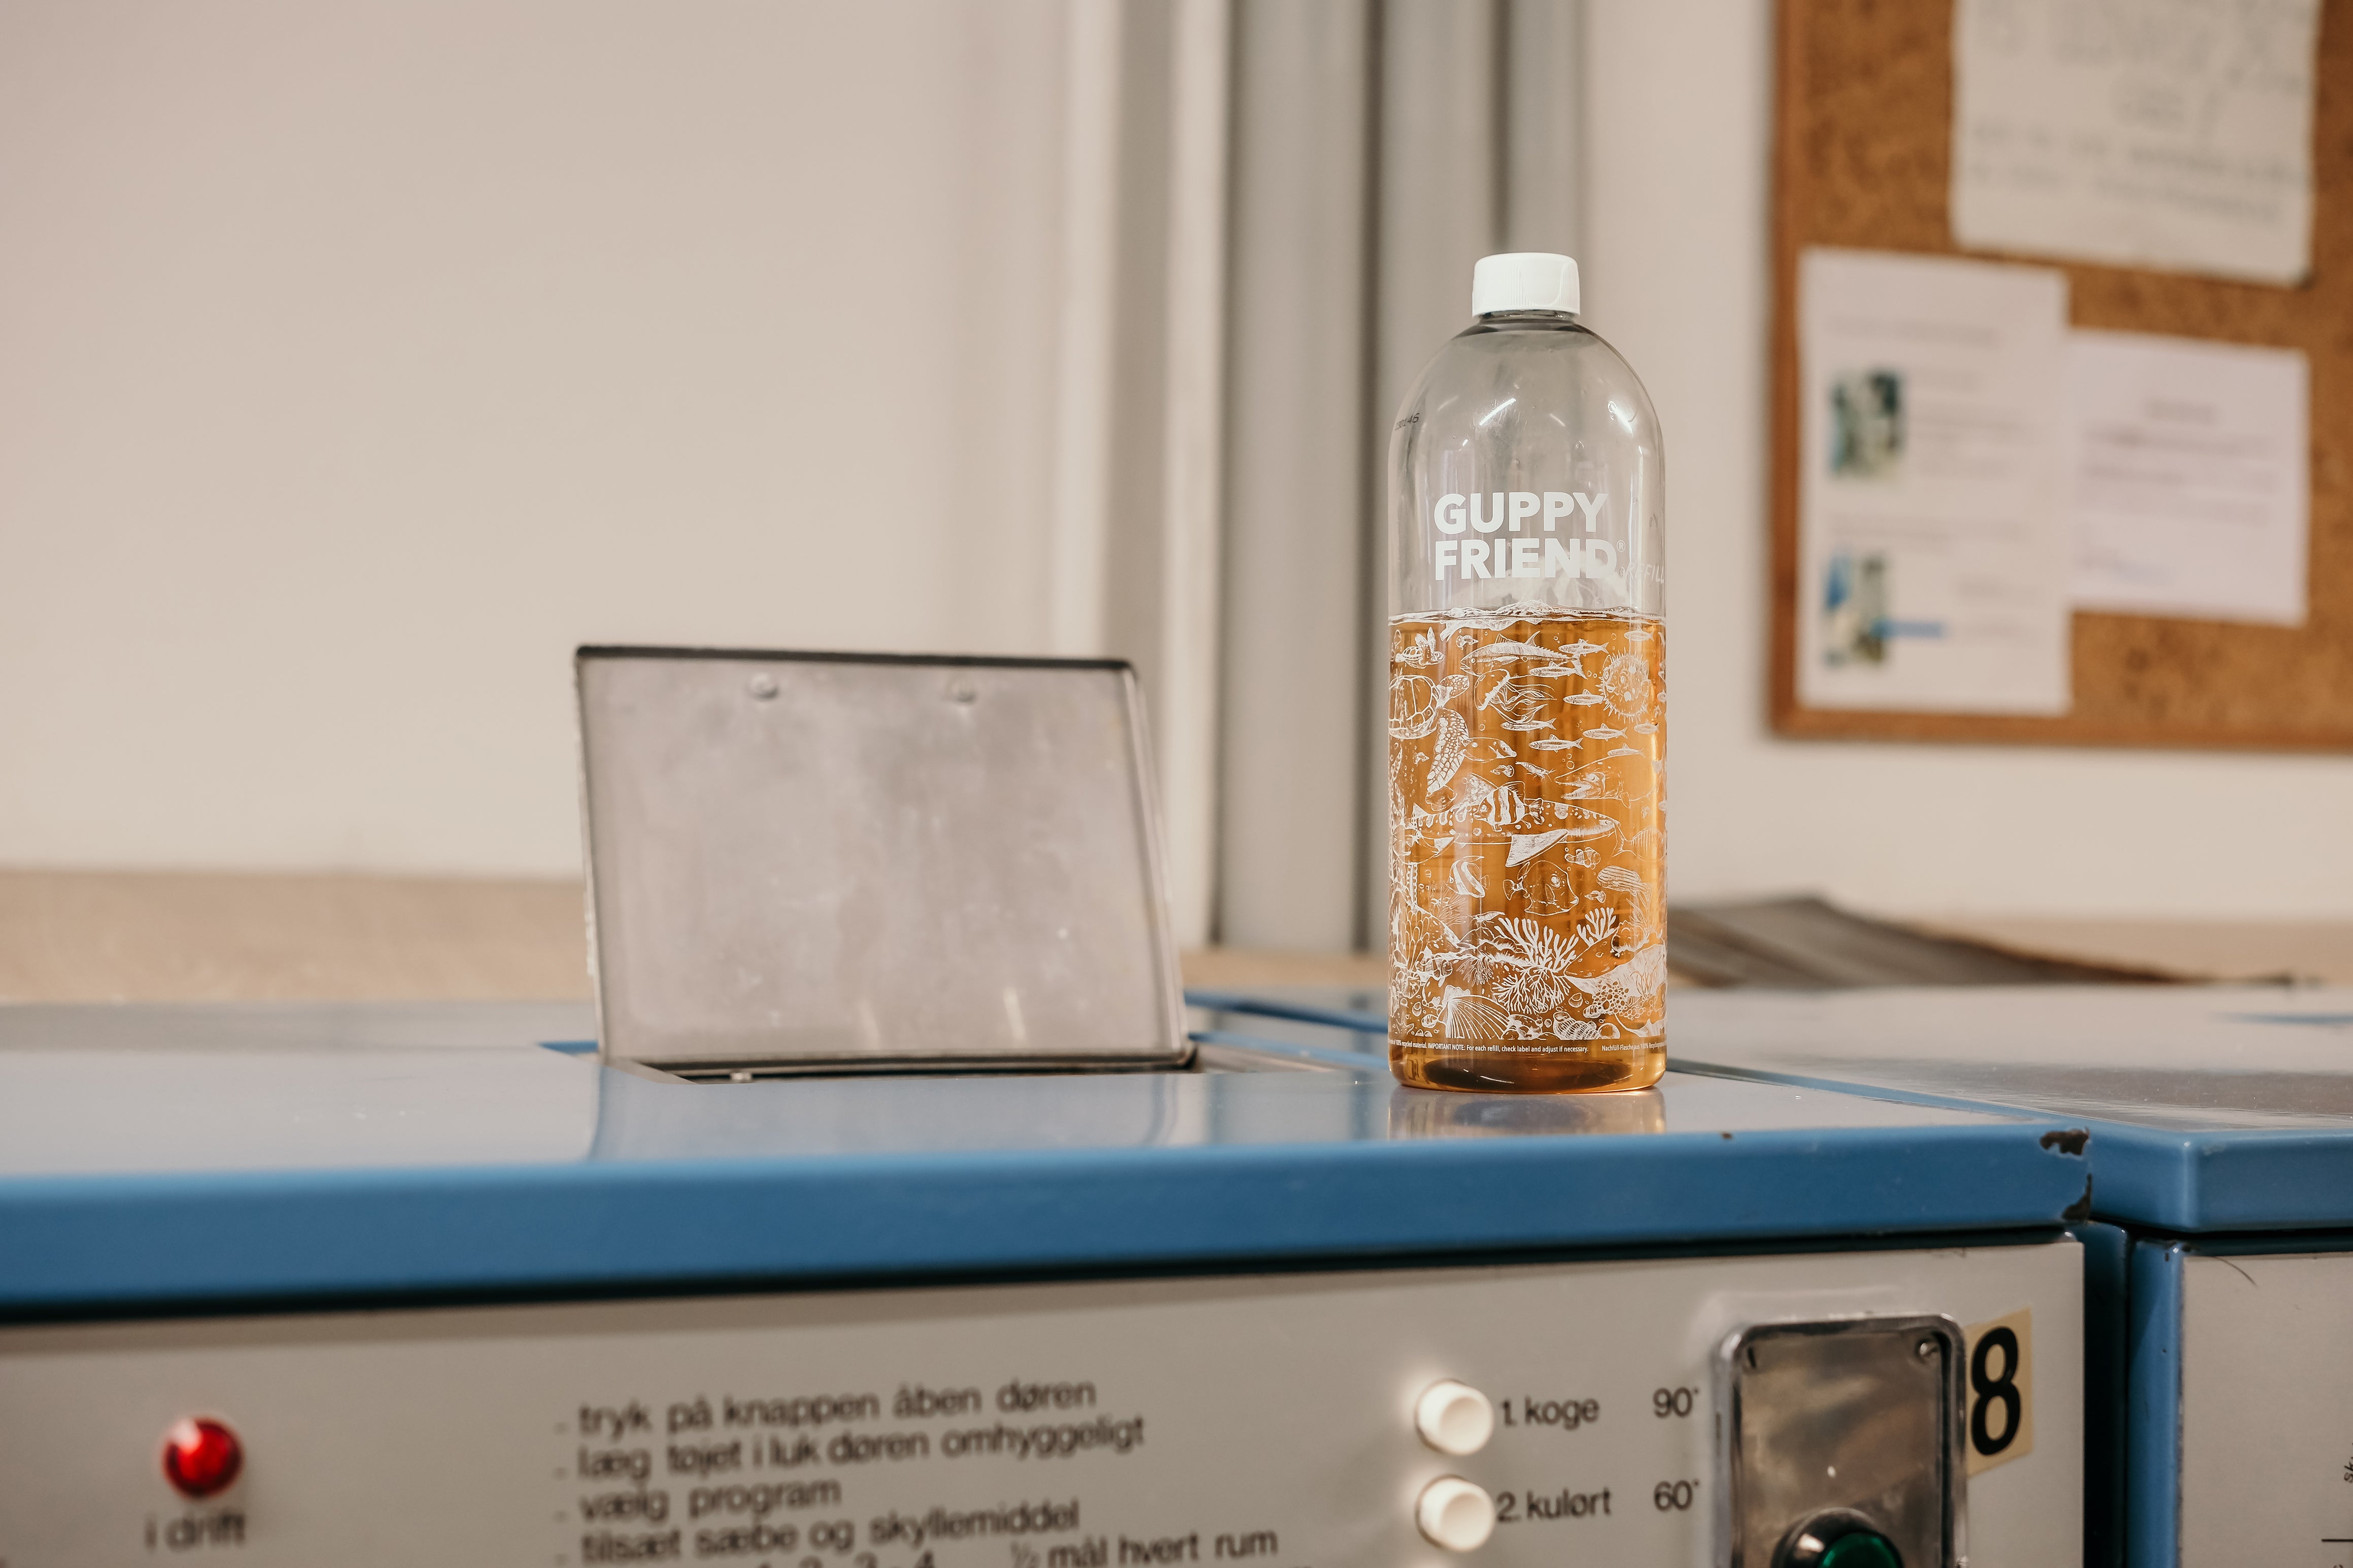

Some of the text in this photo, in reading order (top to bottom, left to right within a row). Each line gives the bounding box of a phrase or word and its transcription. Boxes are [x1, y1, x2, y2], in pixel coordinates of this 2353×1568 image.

[1434, 492, 1608, 535] GUPPY
[578, 1378, 1097, 1442] tryk på knappen åben døren
[1524, 1395, 1599, 1431] koge
[1971, 1325, 2021, 1456] 8
[577, 1445, 652, 1482] læg
[769, 1435, 819, 1468] luk
[827, 1429, 930, 1465] døren
[940, 1413, 1144, 1460] omhyggeligt
[579, 1479, 842, 1525] vælg program
[582, 1496, 1080, 1565] tilsæt sæbe og skyllemiddel
[1047, 1532, 1108, 1568] mål
[1118, 1529, 1199, 1564] hvert
[1215, 1529, 1278, 1559] rum
